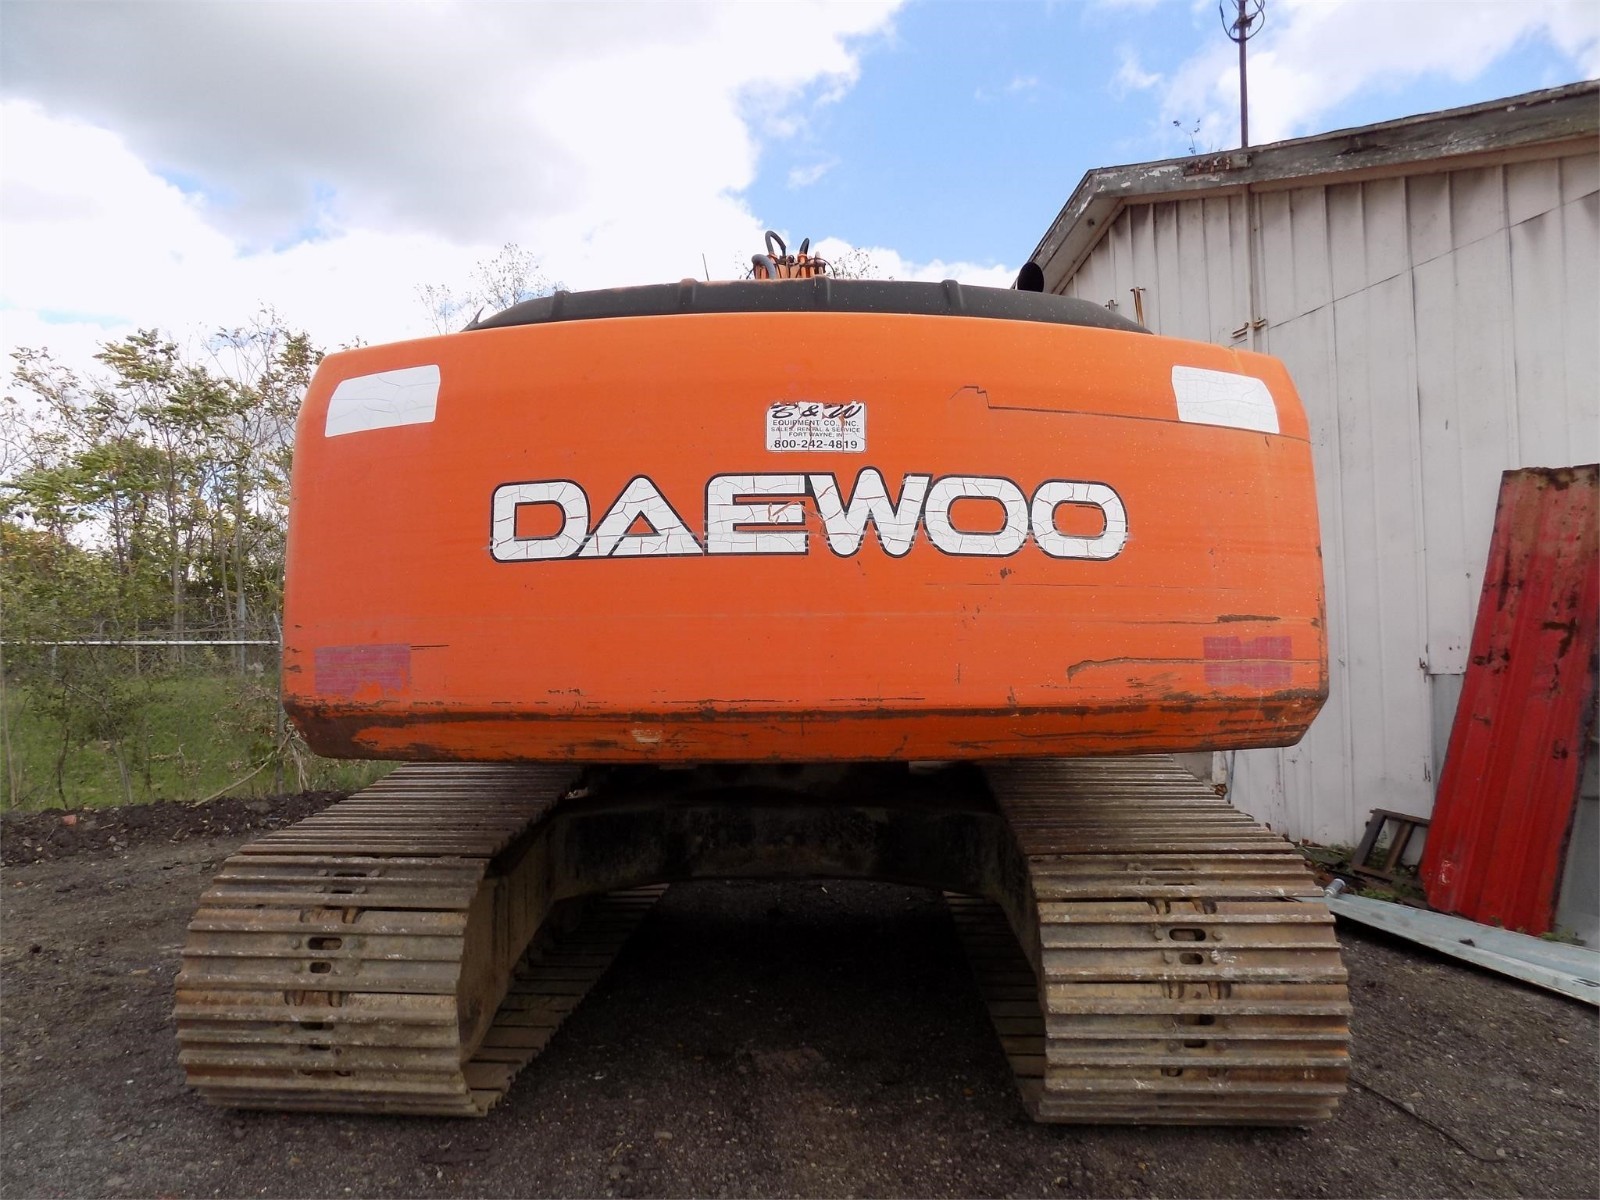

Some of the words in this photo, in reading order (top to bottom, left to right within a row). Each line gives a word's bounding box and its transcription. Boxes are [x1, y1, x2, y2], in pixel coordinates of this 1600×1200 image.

[801, 404, 819, 418] &
[824, 403, 862, 419] W
[774, 439, 858, 449] 800-242-4819
[490, 466, 1128, 562] DAEWOO
